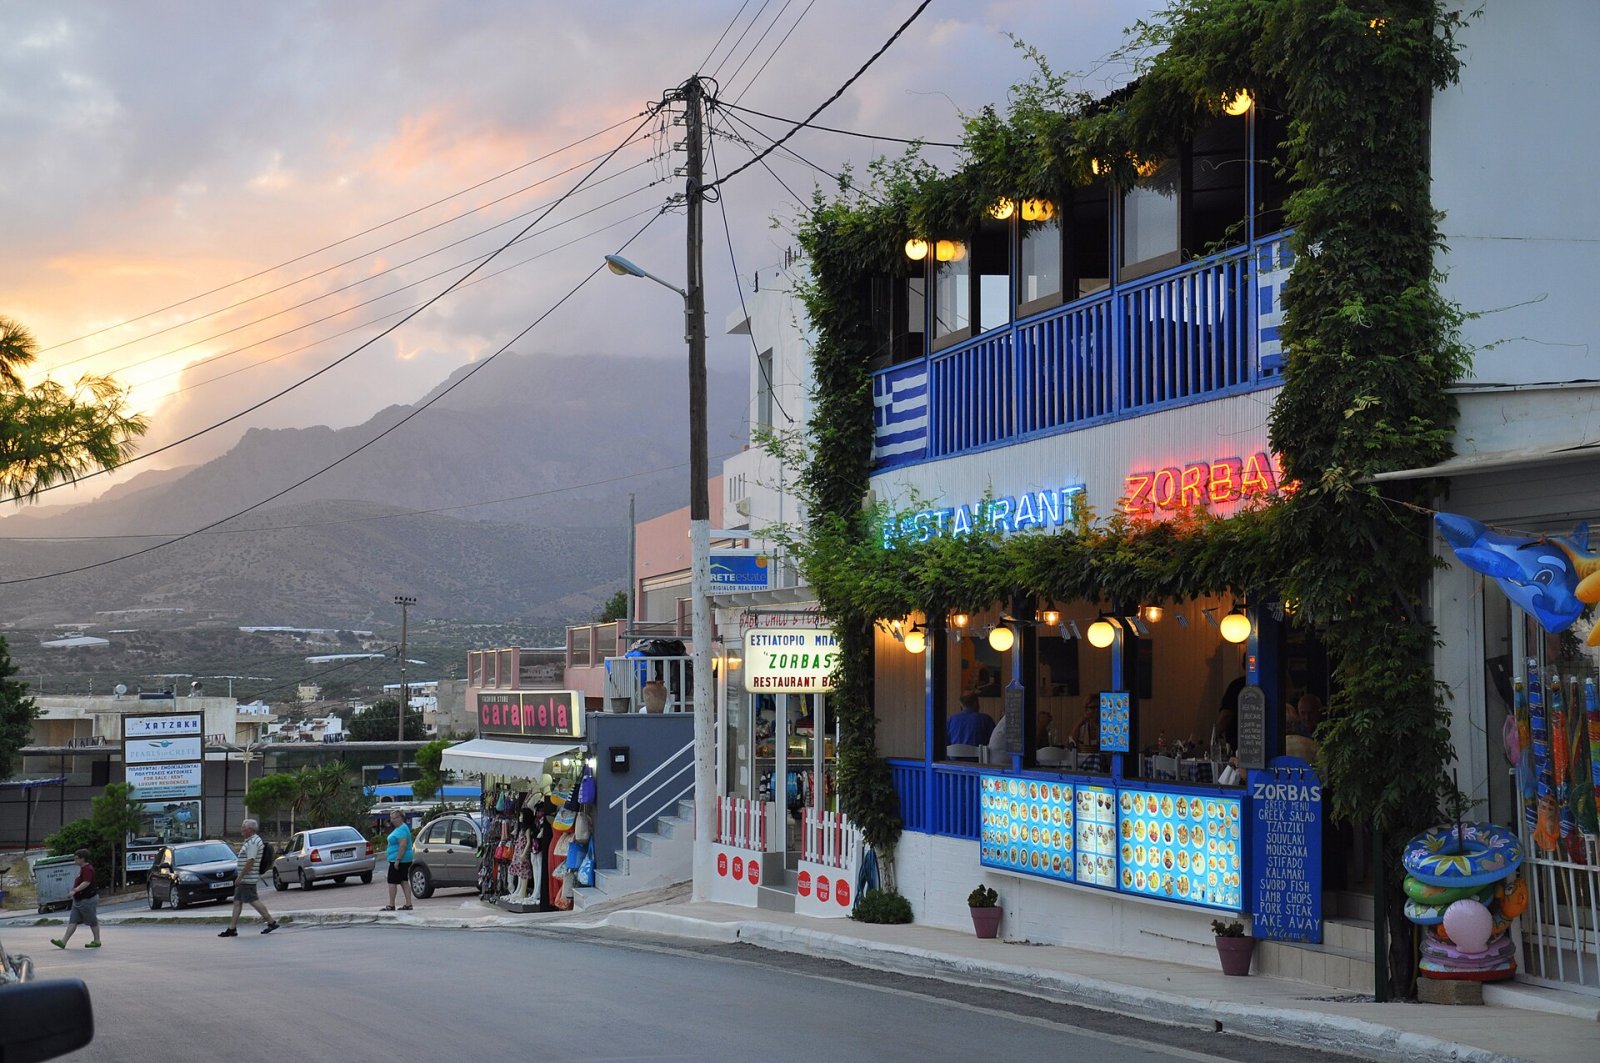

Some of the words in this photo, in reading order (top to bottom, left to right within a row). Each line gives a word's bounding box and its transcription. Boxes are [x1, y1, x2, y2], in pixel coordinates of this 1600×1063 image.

[1124, 451, 1300, 514] ZORBA
[750, 634, 805, 646] ΕΣΤΙΑΤΟΡΙΟ
[753, 676, 816, 688] RESTAURANT
[821, 676, 838, 688] BA
[481, 697, 568, 728] caramela
[145, 720, 198, 730] ΧΑΤΖΑΚΗ
[1252, 783, 1322, 802] ZORBAS
[1264, 800, 1287, 810] GREEK
[1291, 801, 1310, 811] MENU
[1258, 809, 1285, 820] GREEK
[1289, 810, 1316, 822] SALAD
[1266, 821, 1304, 833] TZATZIKI
[1266, 832, 1305, 845] SOUVLAKI
[1266, 844, 1308, 858] MOUSSAKA
[1267, 856, 1303, 869] STIFADO
[1265, 867, 1305, 880] KALAMARI
[1260, 878, 1286, 890] SWORD
[1290, 880, 1310, 893] FISH
[1260, 890, 1281, 902] LAMB
[1286, 892, 1313, 905] CHOPS
[1260, 901, 1282, 914] PORK
[1285, 904, 1313, 917] STEAK
[1253, 913, 1283, 927] TAKE
[1288, 916, 1320, 931] AWAY
